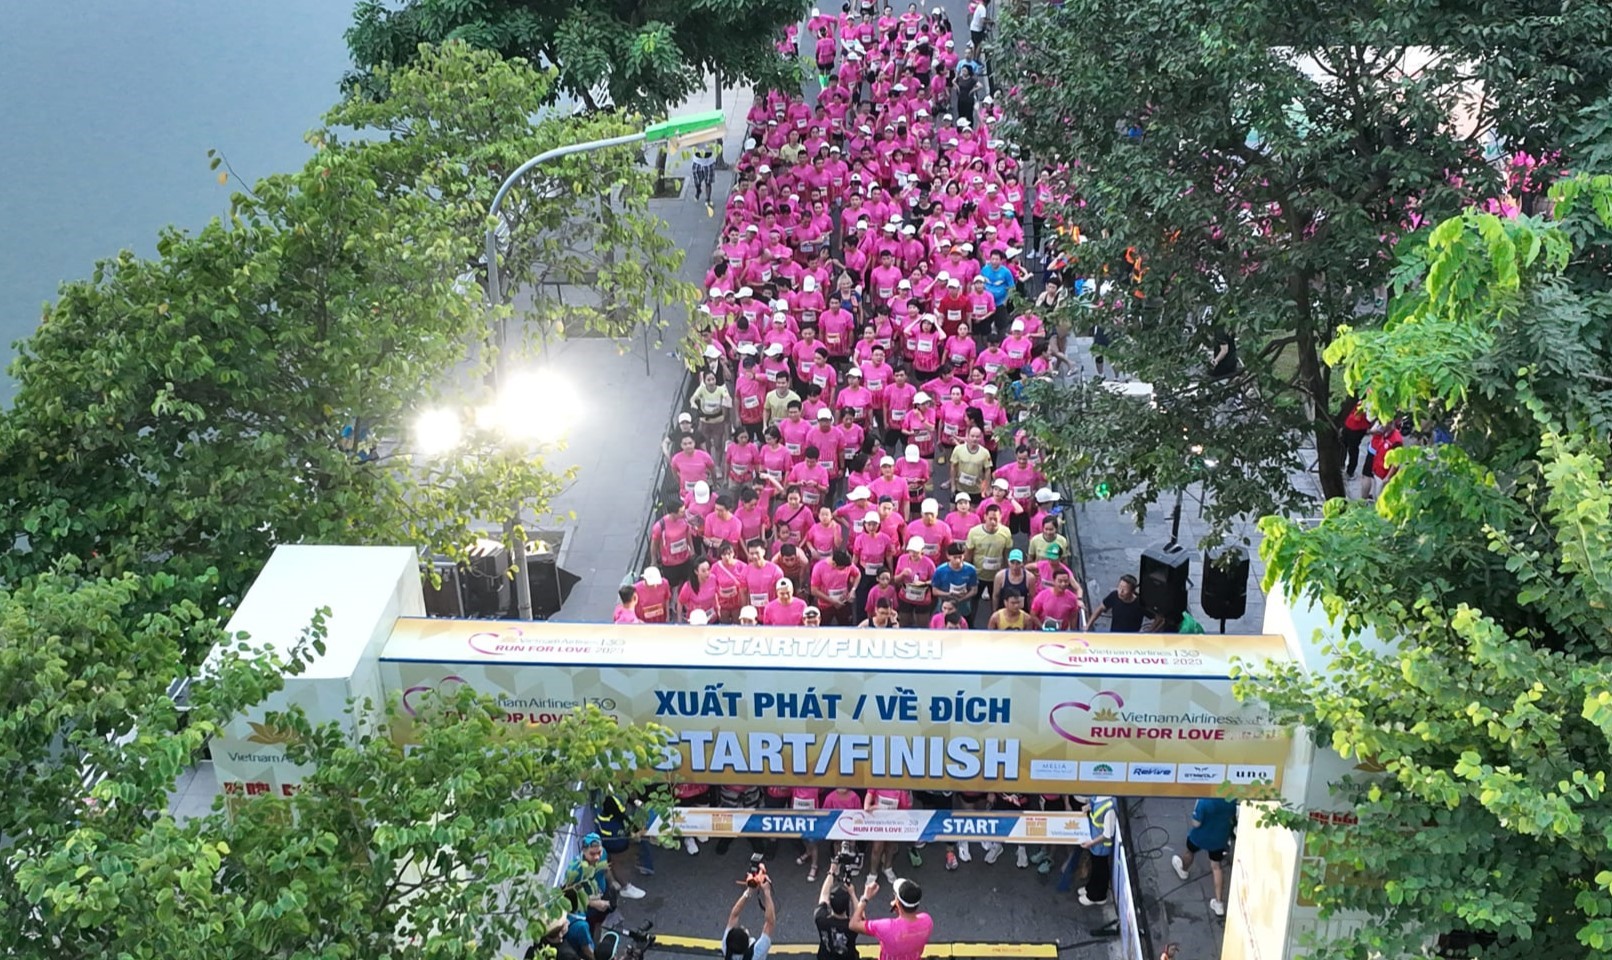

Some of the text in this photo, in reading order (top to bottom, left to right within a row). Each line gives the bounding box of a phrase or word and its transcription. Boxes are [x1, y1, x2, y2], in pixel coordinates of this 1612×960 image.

[527, 645, 554, 653] FOR
[704, 637, 943, 659] START/FINISH
[1134, 657, 1169, 665] LOVE
[1173, 658, 1203, 666] 2023
[654, 683, 1011, 723] XUẤT PHÁT / VỀ ĐÍCH
[1121, 711, 1180, 724] Vietnam
[1180, 713, 1237, 726] Airlines
[1090, 726, 1132, 738] RUN
[1136, 728, 1173, 740] FOR
[1178, 728, 1225, 741] LOVE
[228, 751, 280, 763] Vietnam
[649, 730, 1020, 780] START/FINISH
[761, 816, 818, 832] START
[942, 818, 999, 835] START
